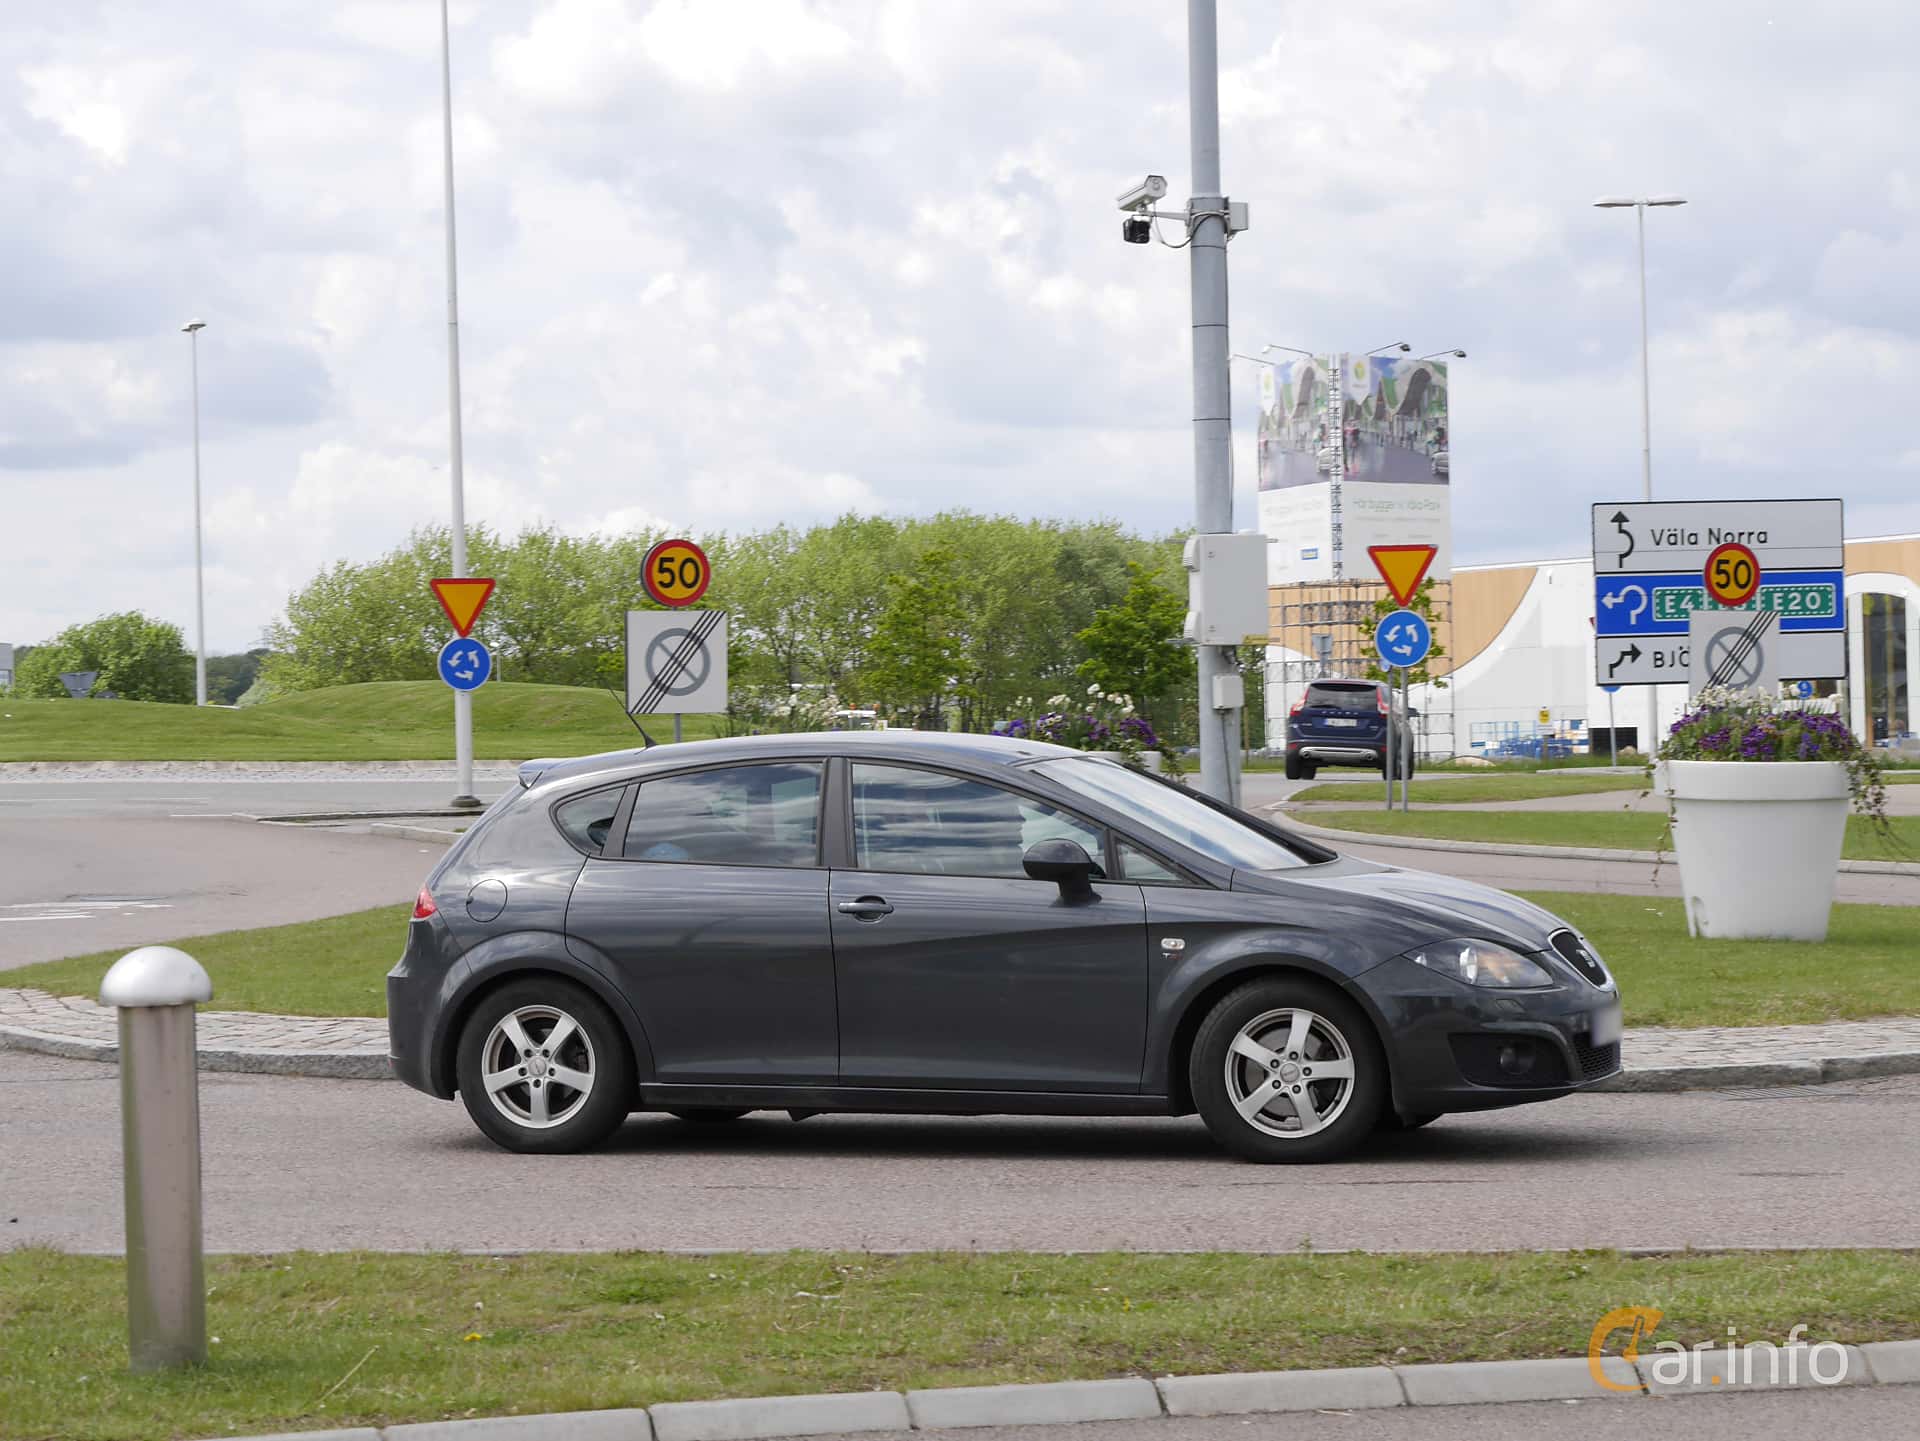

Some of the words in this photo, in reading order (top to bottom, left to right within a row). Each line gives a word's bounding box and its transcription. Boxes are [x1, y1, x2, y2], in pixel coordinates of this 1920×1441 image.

[1650, 528, 1698, 546] Väla
[1708, 527, 1768, 545] Norra
[658, 556, 700, 589] 50
[1714, 559, 1752, 589] 50
[1664, 594, 1695, 613] E4
[1773, 592, 1821, 611] E20
